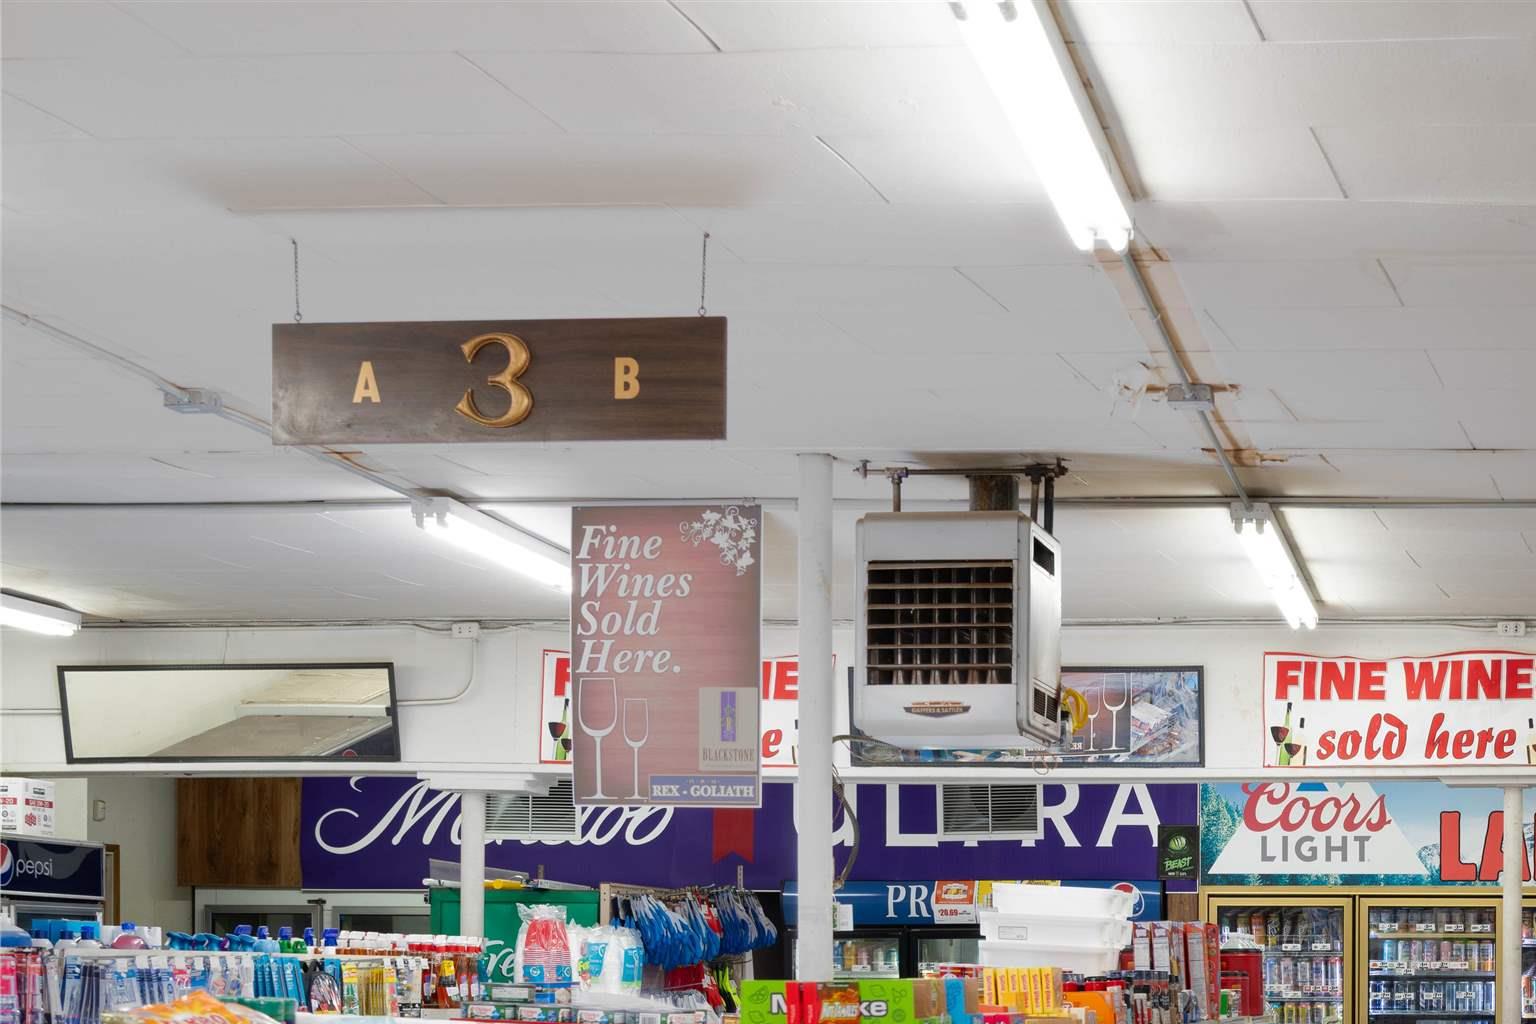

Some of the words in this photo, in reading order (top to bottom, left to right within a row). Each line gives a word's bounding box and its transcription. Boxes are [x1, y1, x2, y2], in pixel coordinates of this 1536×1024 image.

[353, 361, 380, 403] A
[454, 332, 533, 428] 3
[615, 357, 640, 400] B
[576, 525, 661, 561] Fine
[576, 564, 691, 598] Wines
[577, 599, 660, 635] Sold
[576, 639, 681, 673] Here.
[1275, 661, 1387, 700] FINE
[1316, 712, 1408, 760] sold
[1426, 712, 1518, 760] here
[702, 748, 755, 762] BLACKSTONE
[652, 785, 680, 797] REX
[690, 785, 755, 797] GOLIATH
[1242, 782, 1392, 832] Coors
[1261, 835, 1370, 862] LIGHT
[16, 858, 53, 878] pepsi
[886, 885, 936, 919] PR
[860, 1000, 887, 1016] ke
